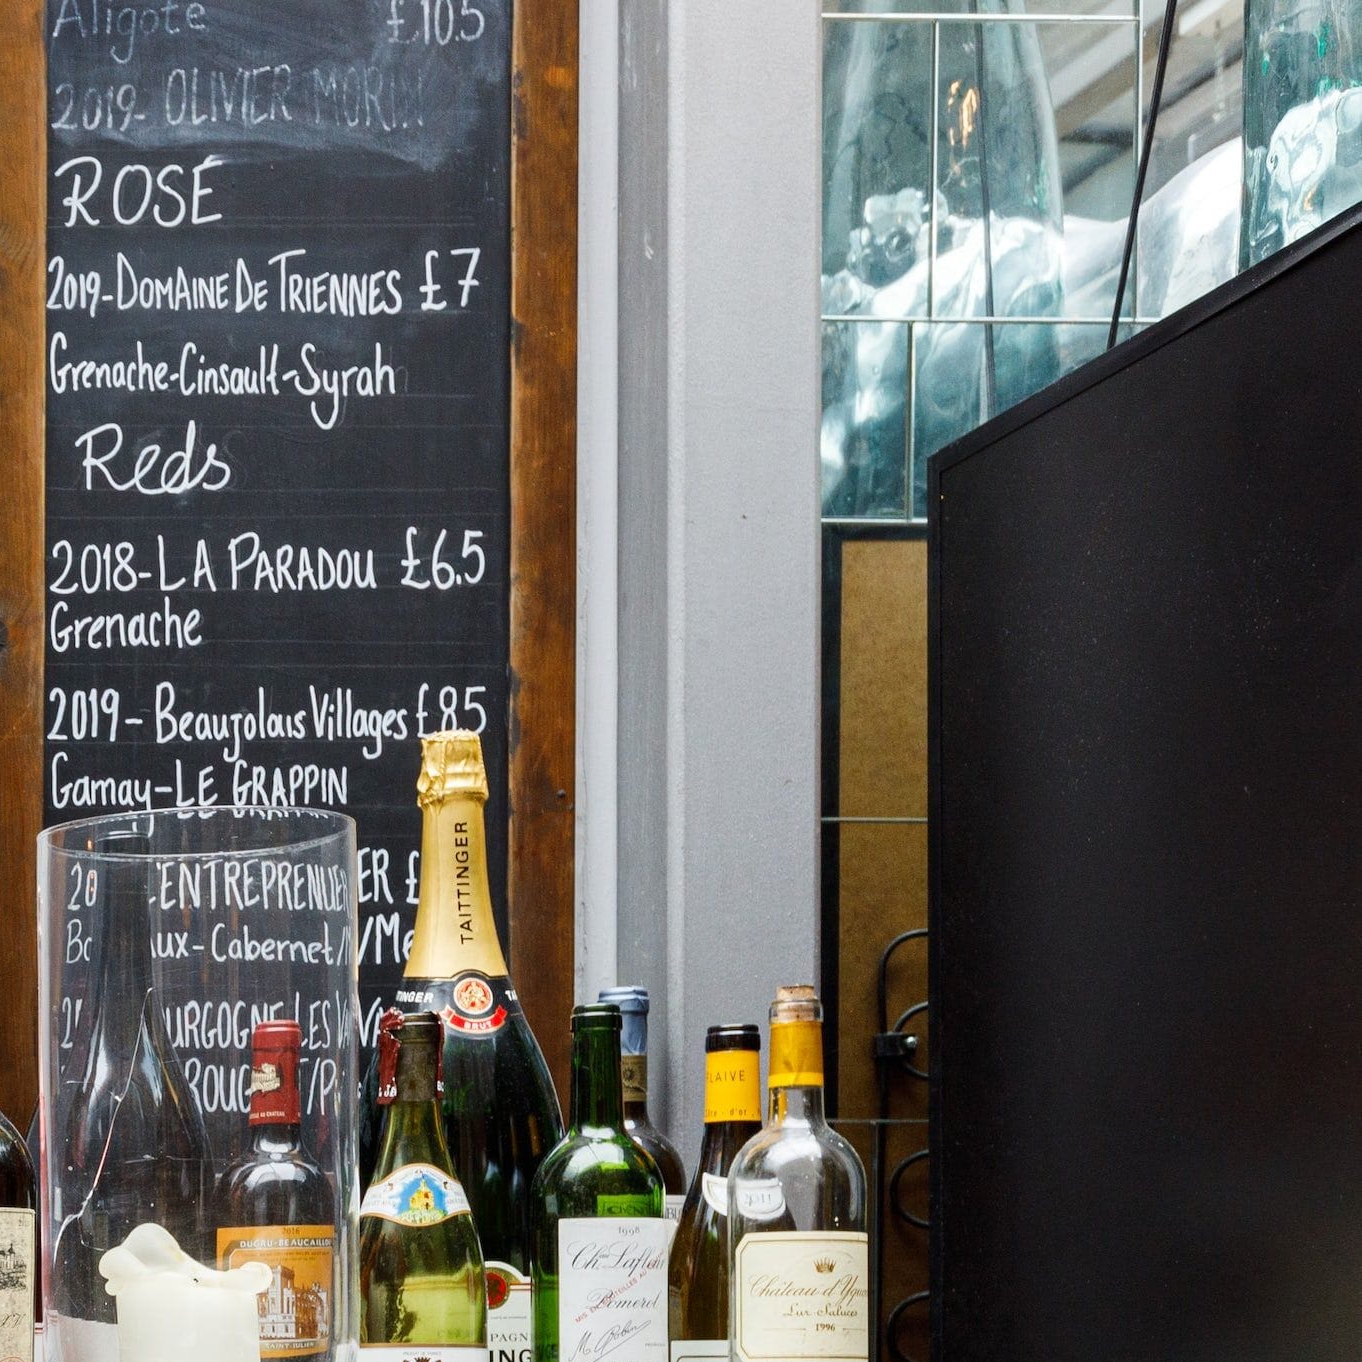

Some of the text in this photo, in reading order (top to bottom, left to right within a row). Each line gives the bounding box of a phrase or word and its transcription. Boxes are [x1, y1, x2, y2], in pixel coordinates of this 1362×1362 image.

[268, 248, 402, 316] TRIENNES
[75, 419, 232, 495] Reds
[228, 531, 377, 593] PARADOU
[400, 526, 487, 591] £6.5
[50, 596, 203, 653] Grenache
[309, 684, 408, 759] Villages
[231, 762, 348, 811] GRAPPIN
[453, 820, 475, 945] TAITTINGER
[748, 1273, 817, 1300] Château
[814, 1322, 837, 1333] 1996
